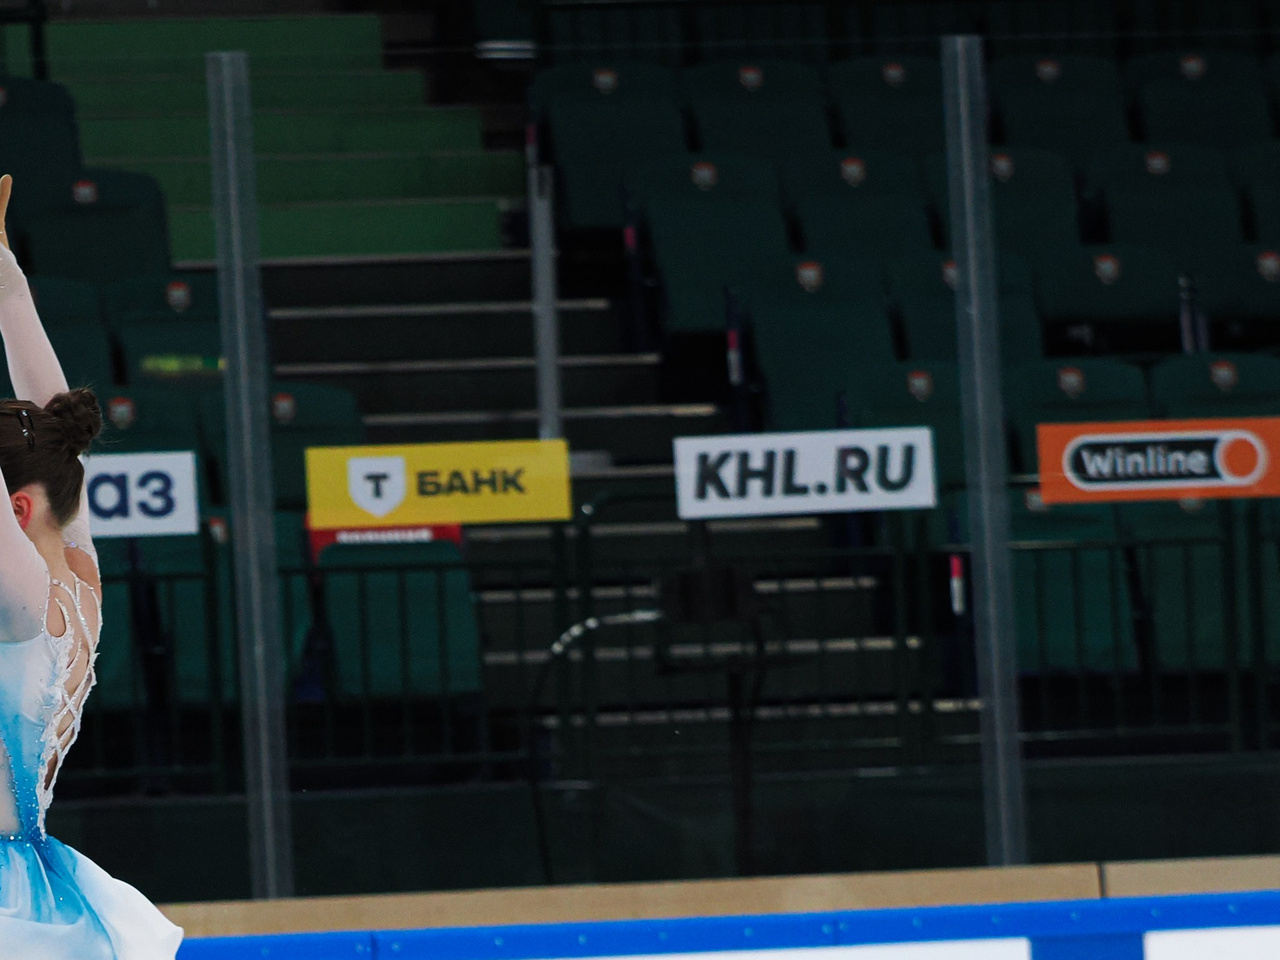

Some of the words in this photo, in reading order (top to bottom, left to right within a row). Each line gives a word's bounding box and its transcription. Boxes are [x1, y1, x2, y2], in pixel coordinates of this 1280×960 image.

[695, 443, 915, 500] KHL.RU
[1079, 445, 1211, 480] Winline
[416, 466, 526, 497] БАНК
